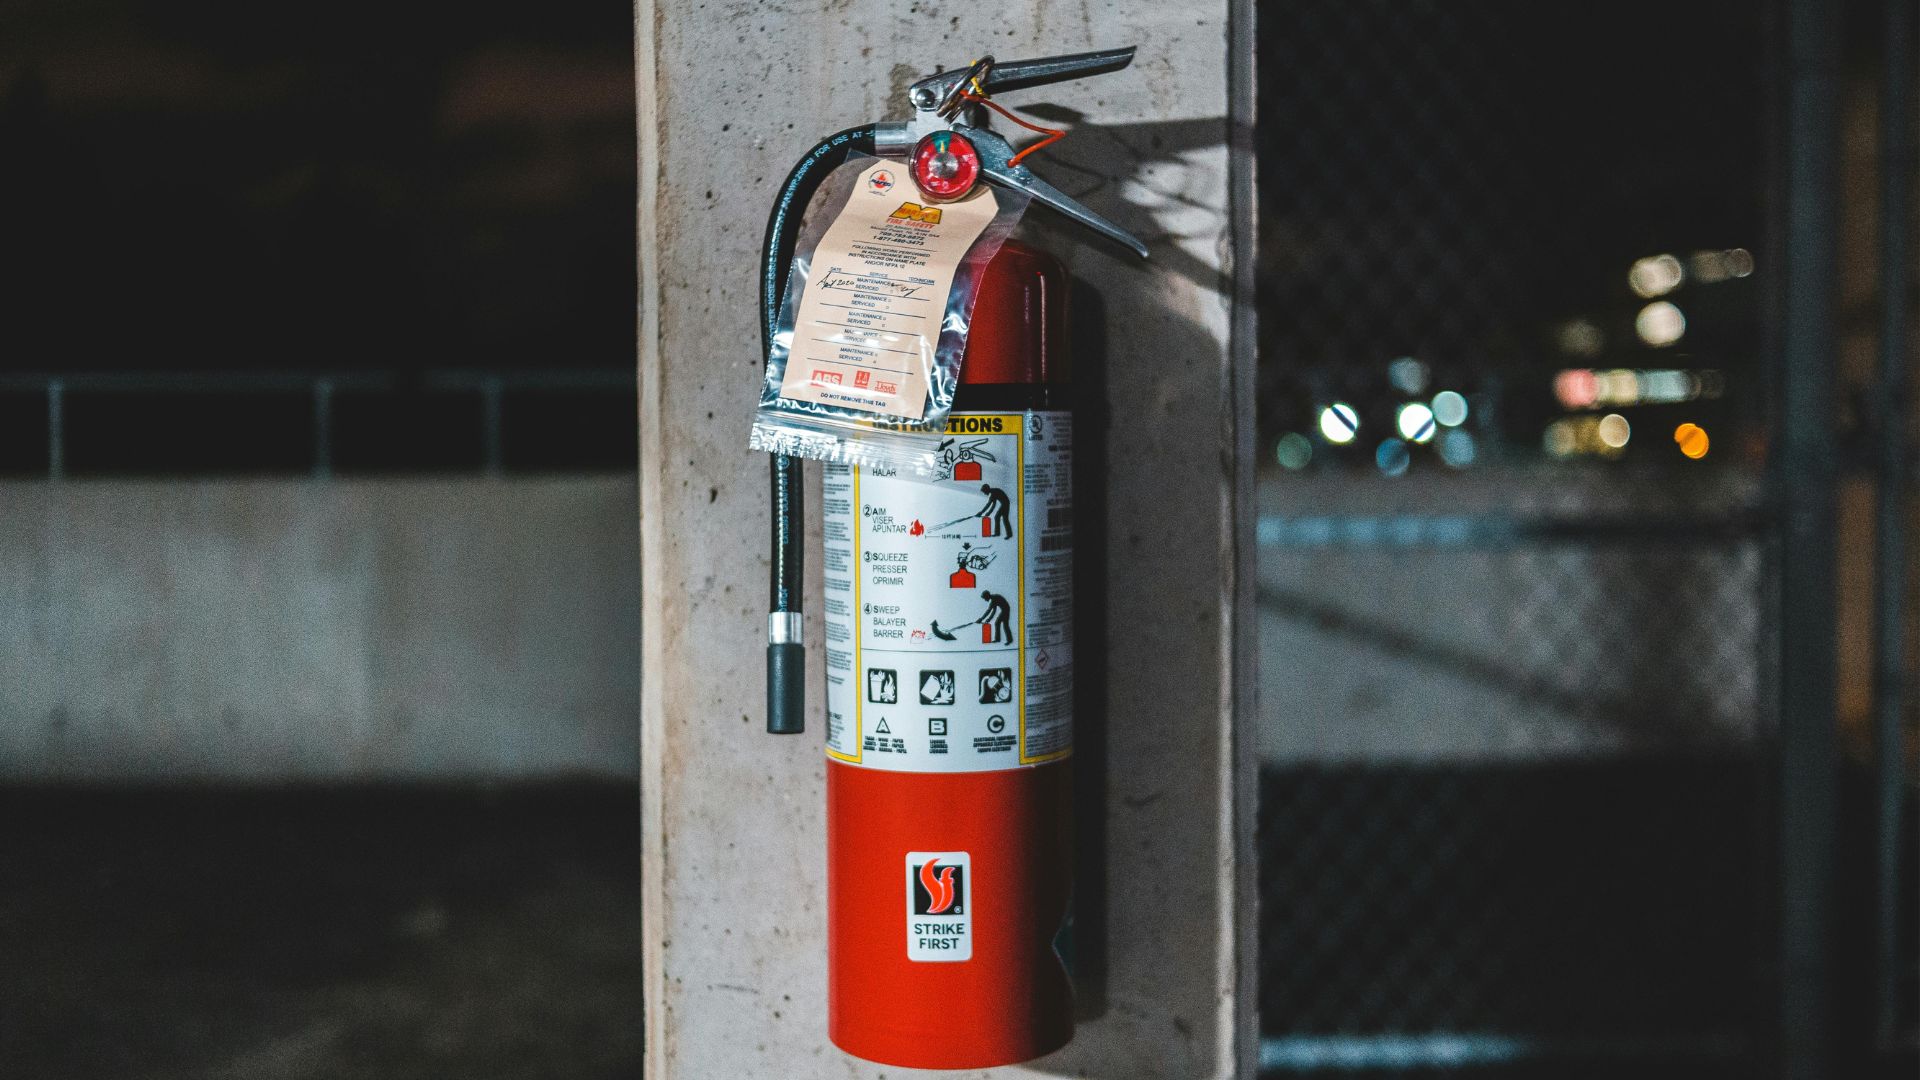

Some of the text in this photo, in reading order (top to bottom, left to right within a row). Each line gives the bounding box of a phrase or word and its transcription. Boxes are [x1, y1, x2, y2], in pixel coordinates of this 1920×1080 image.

[814, 144, 831, 158] FOR
[831, 134, 849, 146] USE
[852, 131, 862, 139] AT
[905, 220, 935, 229] SAFETY
[852, 244, 881, 252] FOLLOWING
[899, 250, 931, 258] PERFORMED
[870, 251, 902, 259] ACCORDANCE
[848, 252, 885, 261] INSTRUCTIONS
[856, 277, 891, 287] MAINTENANCE
[908, 276, 935, 286] TECHNICIAN
[855, 284, 879, 292] SERVICED
[853, 293, 887, 302] MAINTENANCE
[851, 299, 875, 307] SERVICED
[848, 311, 882, 320] MAINTENANCE
[847, 317, 871, 326] SERVICED
[839, 347, 874, 357] MAINTENANCE
[838, 354, 862, 362] SERVICED
[840, 395, 861, 403] REMOVE
[872, 468, 897, 478] HALAR
[872, 507, 886, 516] AIM
[872, 516, 894, 525] VISER
[872, 525, 907, 534] APUNTAR
[872, 553, 909, 562] SQUEEZE
[872, 565, 908, 574] PRESSER
[872, 577, 905, 586] OPRIMIR
[873, 605, 901, 614] SWEEP
[873, 618, 906, 627] BALAYER
[873, 629, 904, 639] BARRER
[914, 923, 965, 935] STRIKE
[919, 938, 960, 949] FIRST
